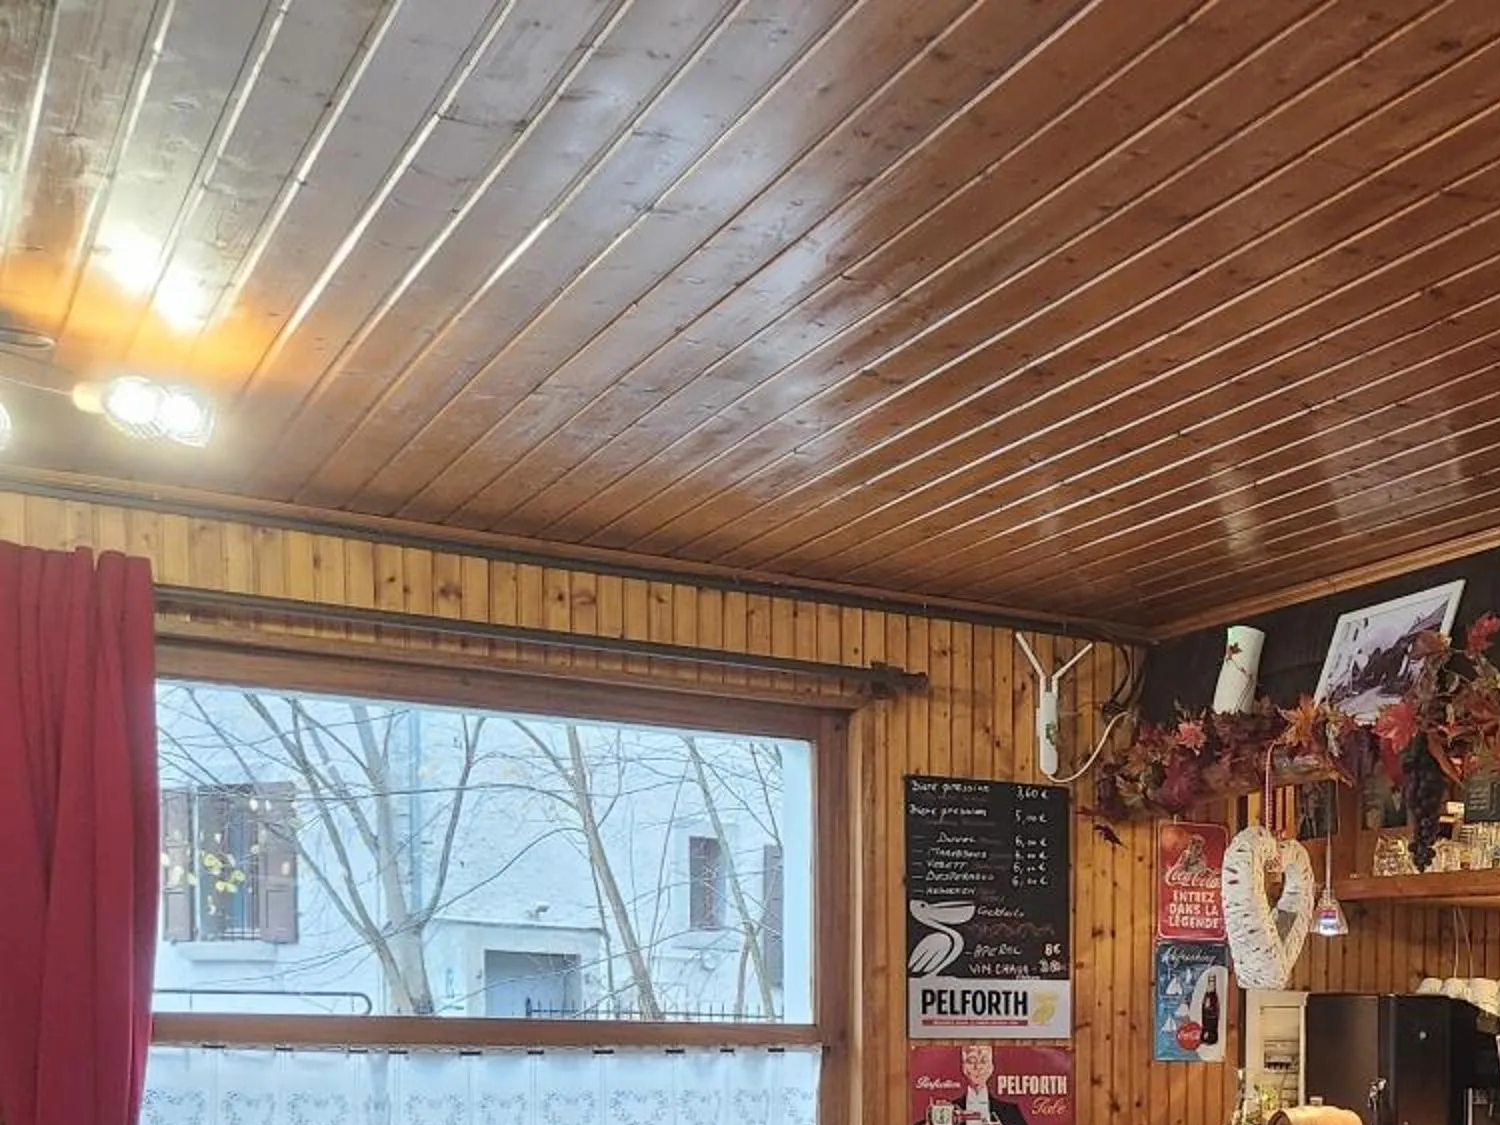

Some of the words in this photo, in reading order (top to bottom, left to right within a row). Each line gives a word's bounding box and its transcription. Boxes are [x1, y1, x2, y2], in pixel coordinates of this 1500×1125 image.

[1173, 889, 1216, 904] ENTREZ
[1168, 902, 1201, 916] DANS
[1205, 903, 1219, 917] LA
[921, 989, 1028, 1016] PELFORTH
[997, 1074, 1068, 1096] PELFORTH
